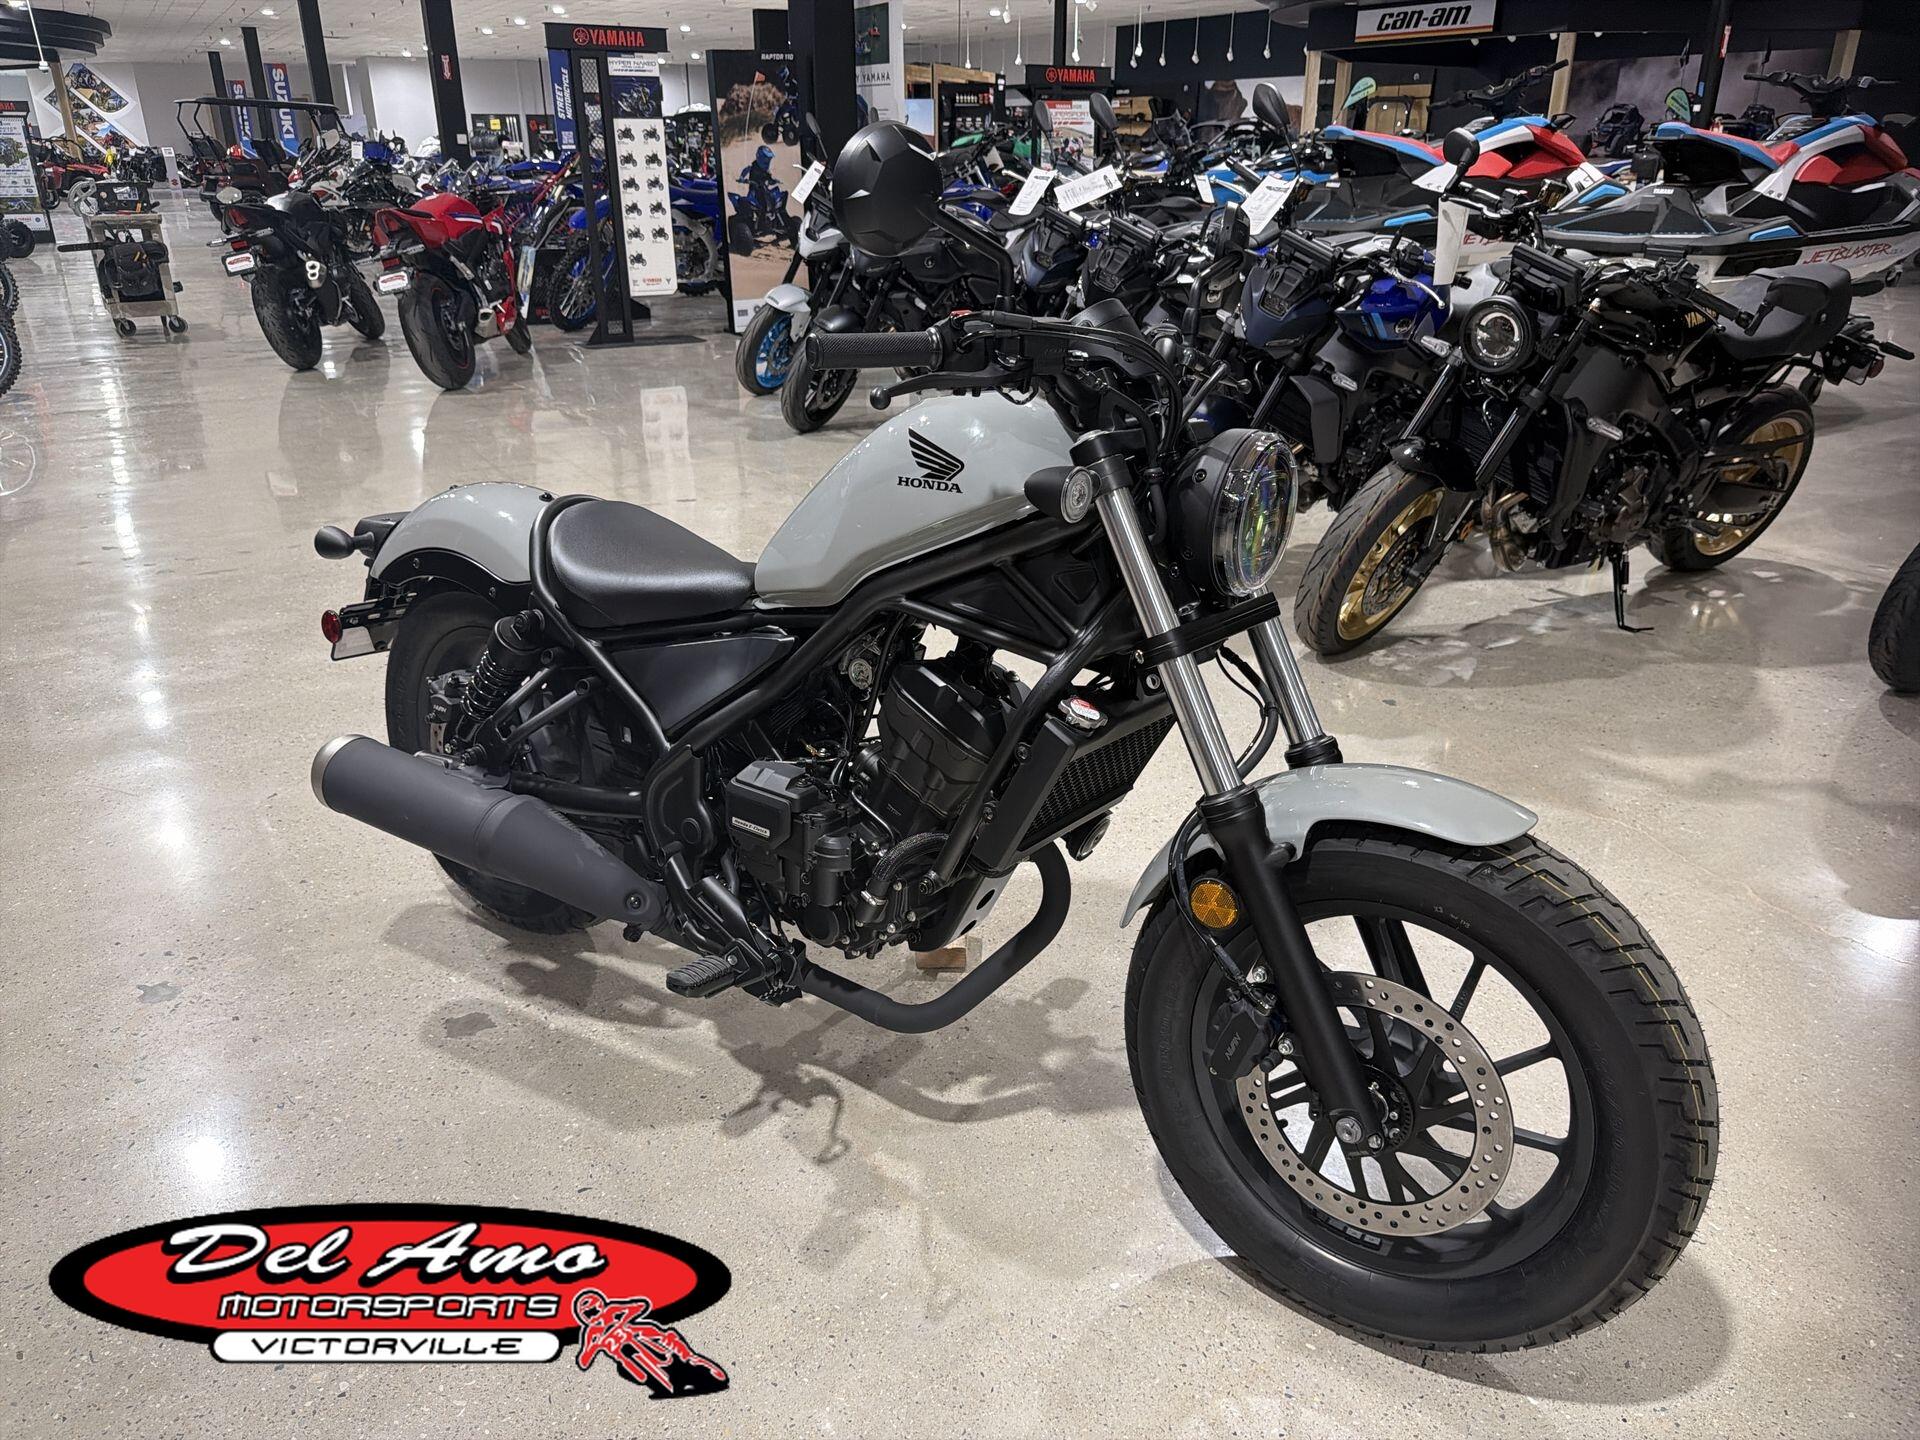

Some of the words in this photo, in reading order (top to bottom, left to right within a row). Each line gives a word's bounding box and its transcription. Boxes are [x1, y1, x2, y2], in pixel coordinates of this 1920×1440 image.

[1376, 5, 1472, 31] can-am
[590, 29, 645, 47] YAMAHA
[862, 71, 891, 83] YAMAHA
[1057, 68, 1095, 83] YAMAHA
[272, 68, 295, 139] SUZUKI
[554, 83, 566, 120] STREET
[561, 67, 573, 120] MOTORCYCLE
[1803, 242, 1892, 265] JETBLASTER
[896, 476, 964, 494] HONDA
